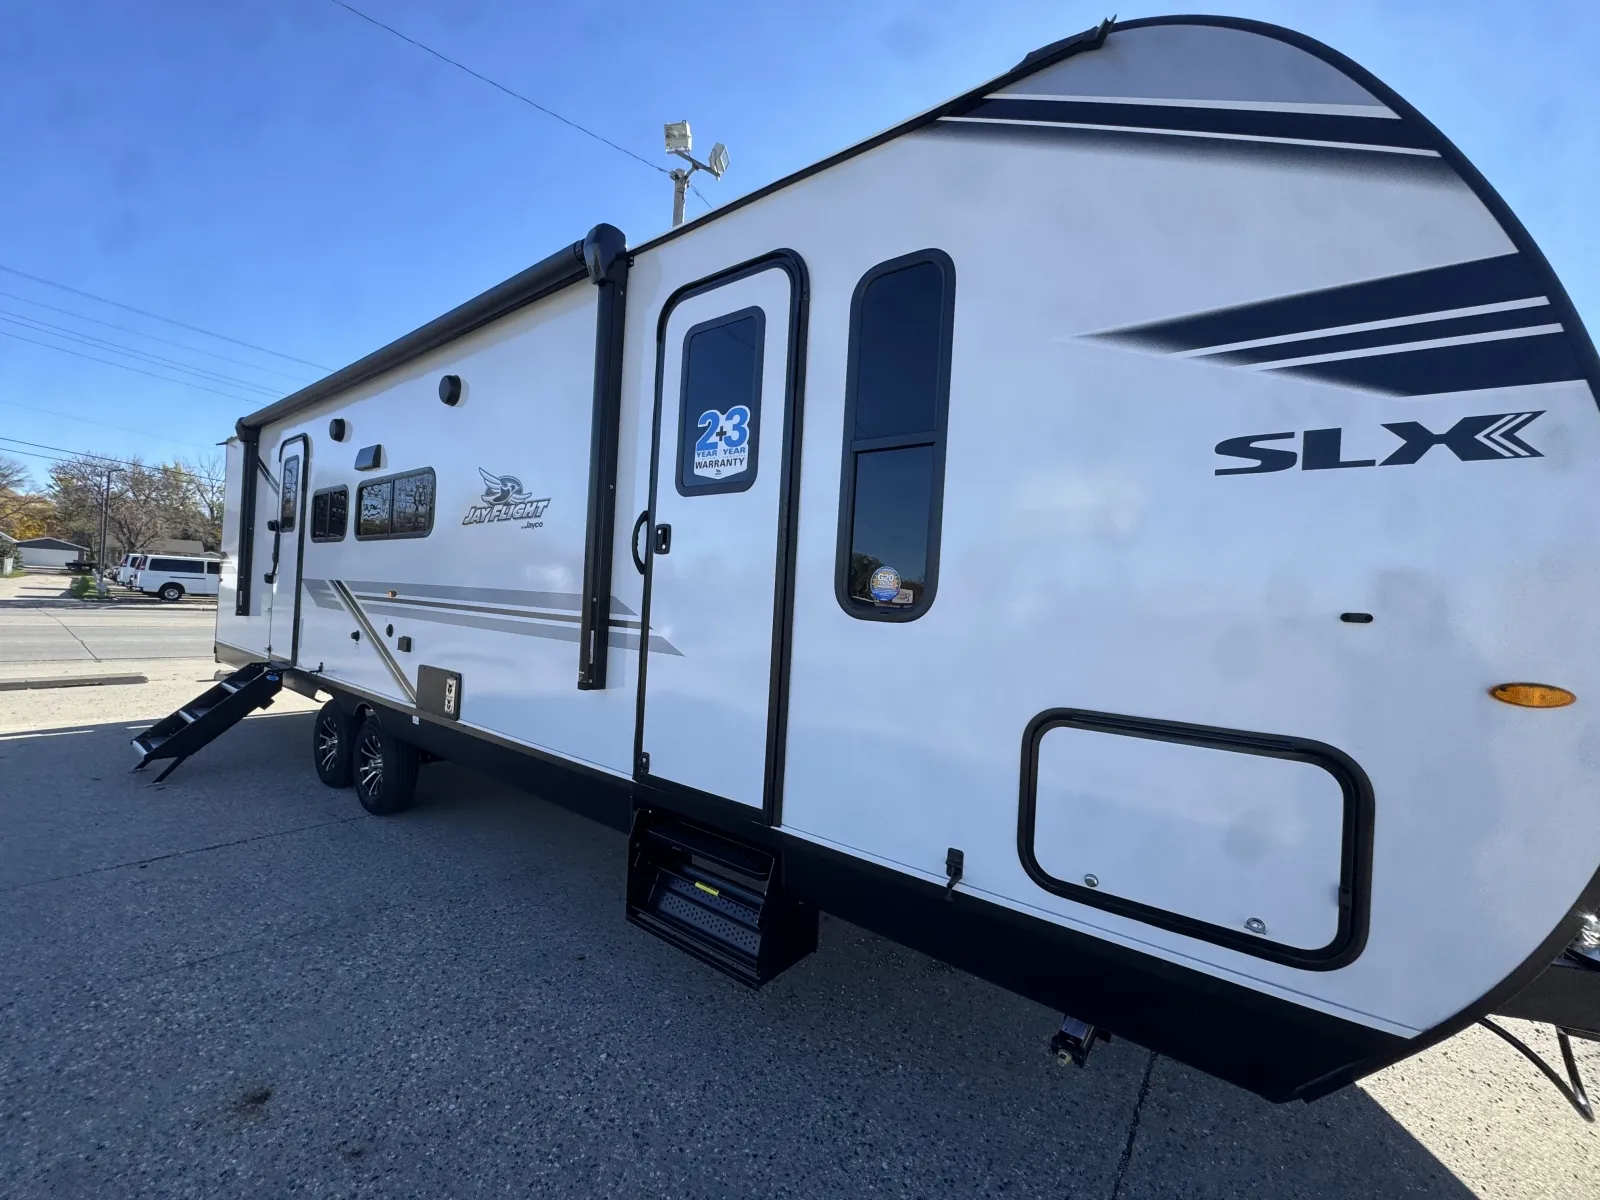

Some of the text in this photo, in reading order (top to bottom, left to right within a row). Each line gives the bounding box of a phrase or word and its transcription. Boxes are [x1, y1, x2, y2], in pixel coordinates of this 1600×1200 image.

[1214, 410, 1547, 476] SLX
[723, 447, 746, 455] YEAR
[695, 457, 745, 469] WARRANTY
[526, 521, 544, 530] Jayco
